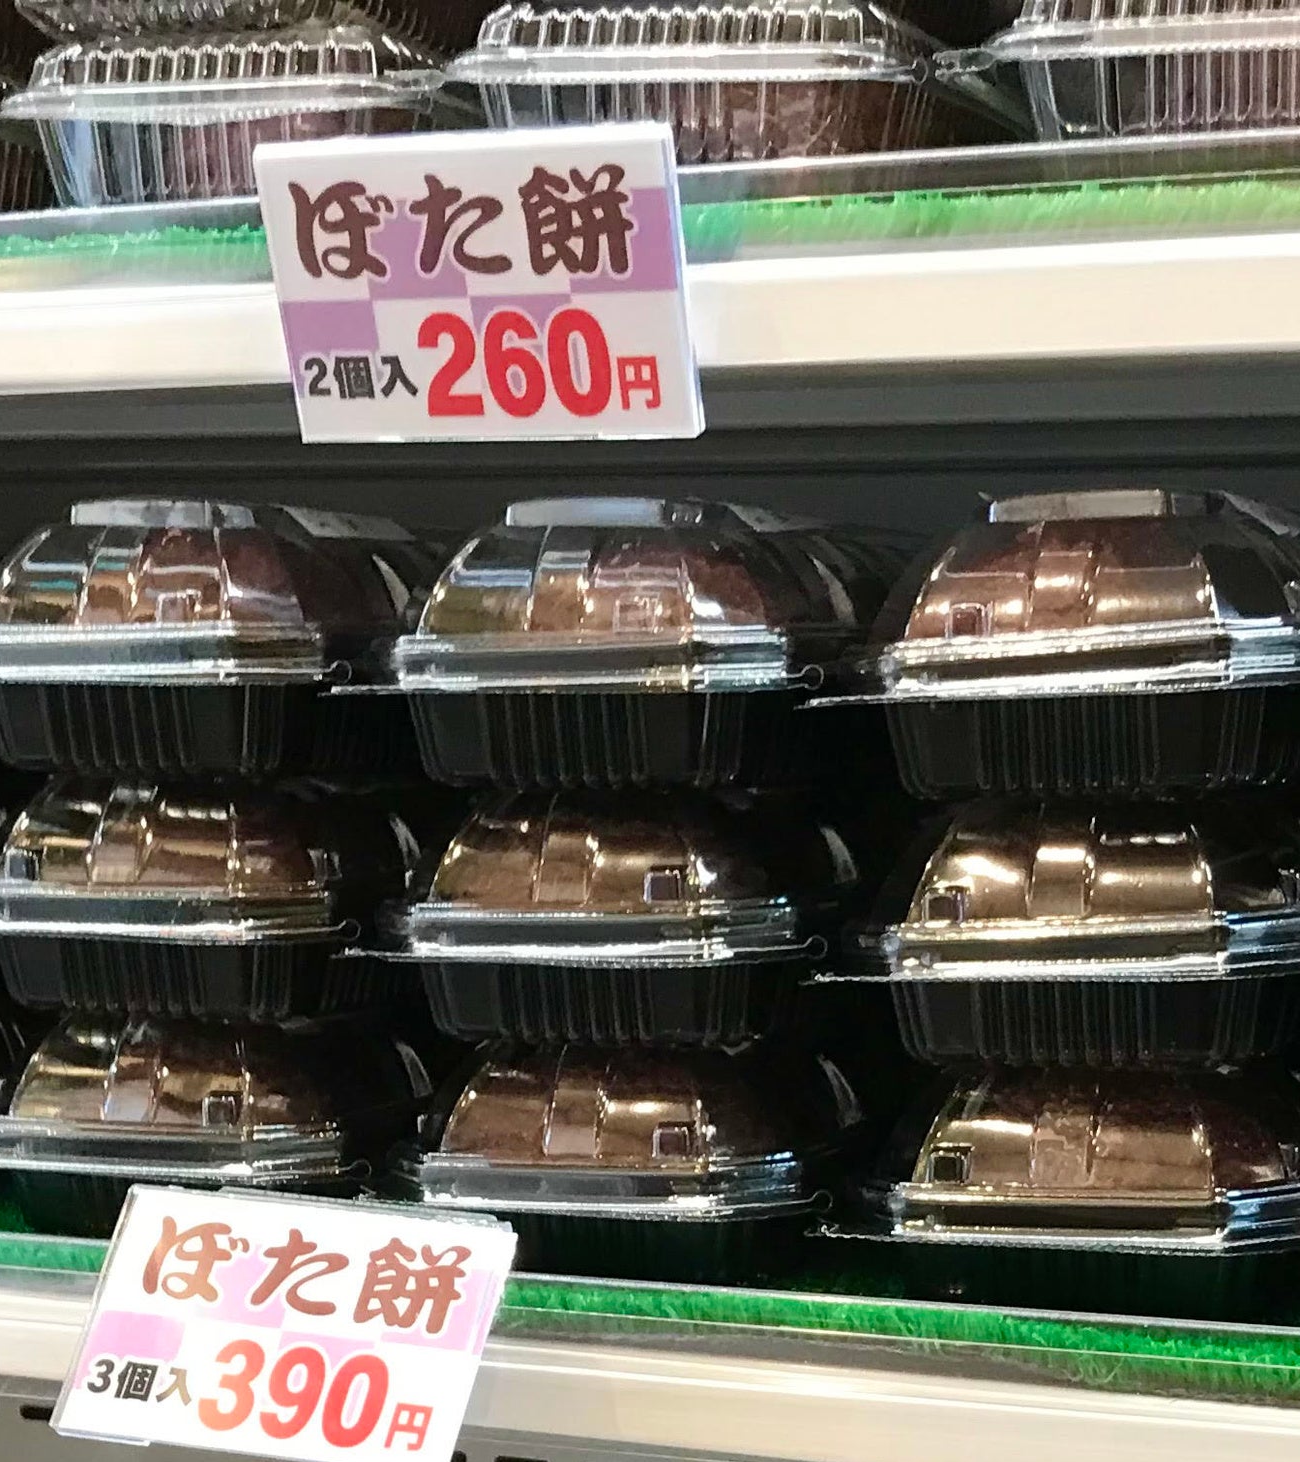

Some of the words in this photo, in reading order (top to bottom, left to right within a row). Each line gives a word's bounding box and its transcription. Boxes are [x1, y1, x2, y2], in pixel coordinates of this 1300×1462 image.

[288, 164, 634, 279] ぼた餅
[142, 1215, 472, 1335] ぼた餅
